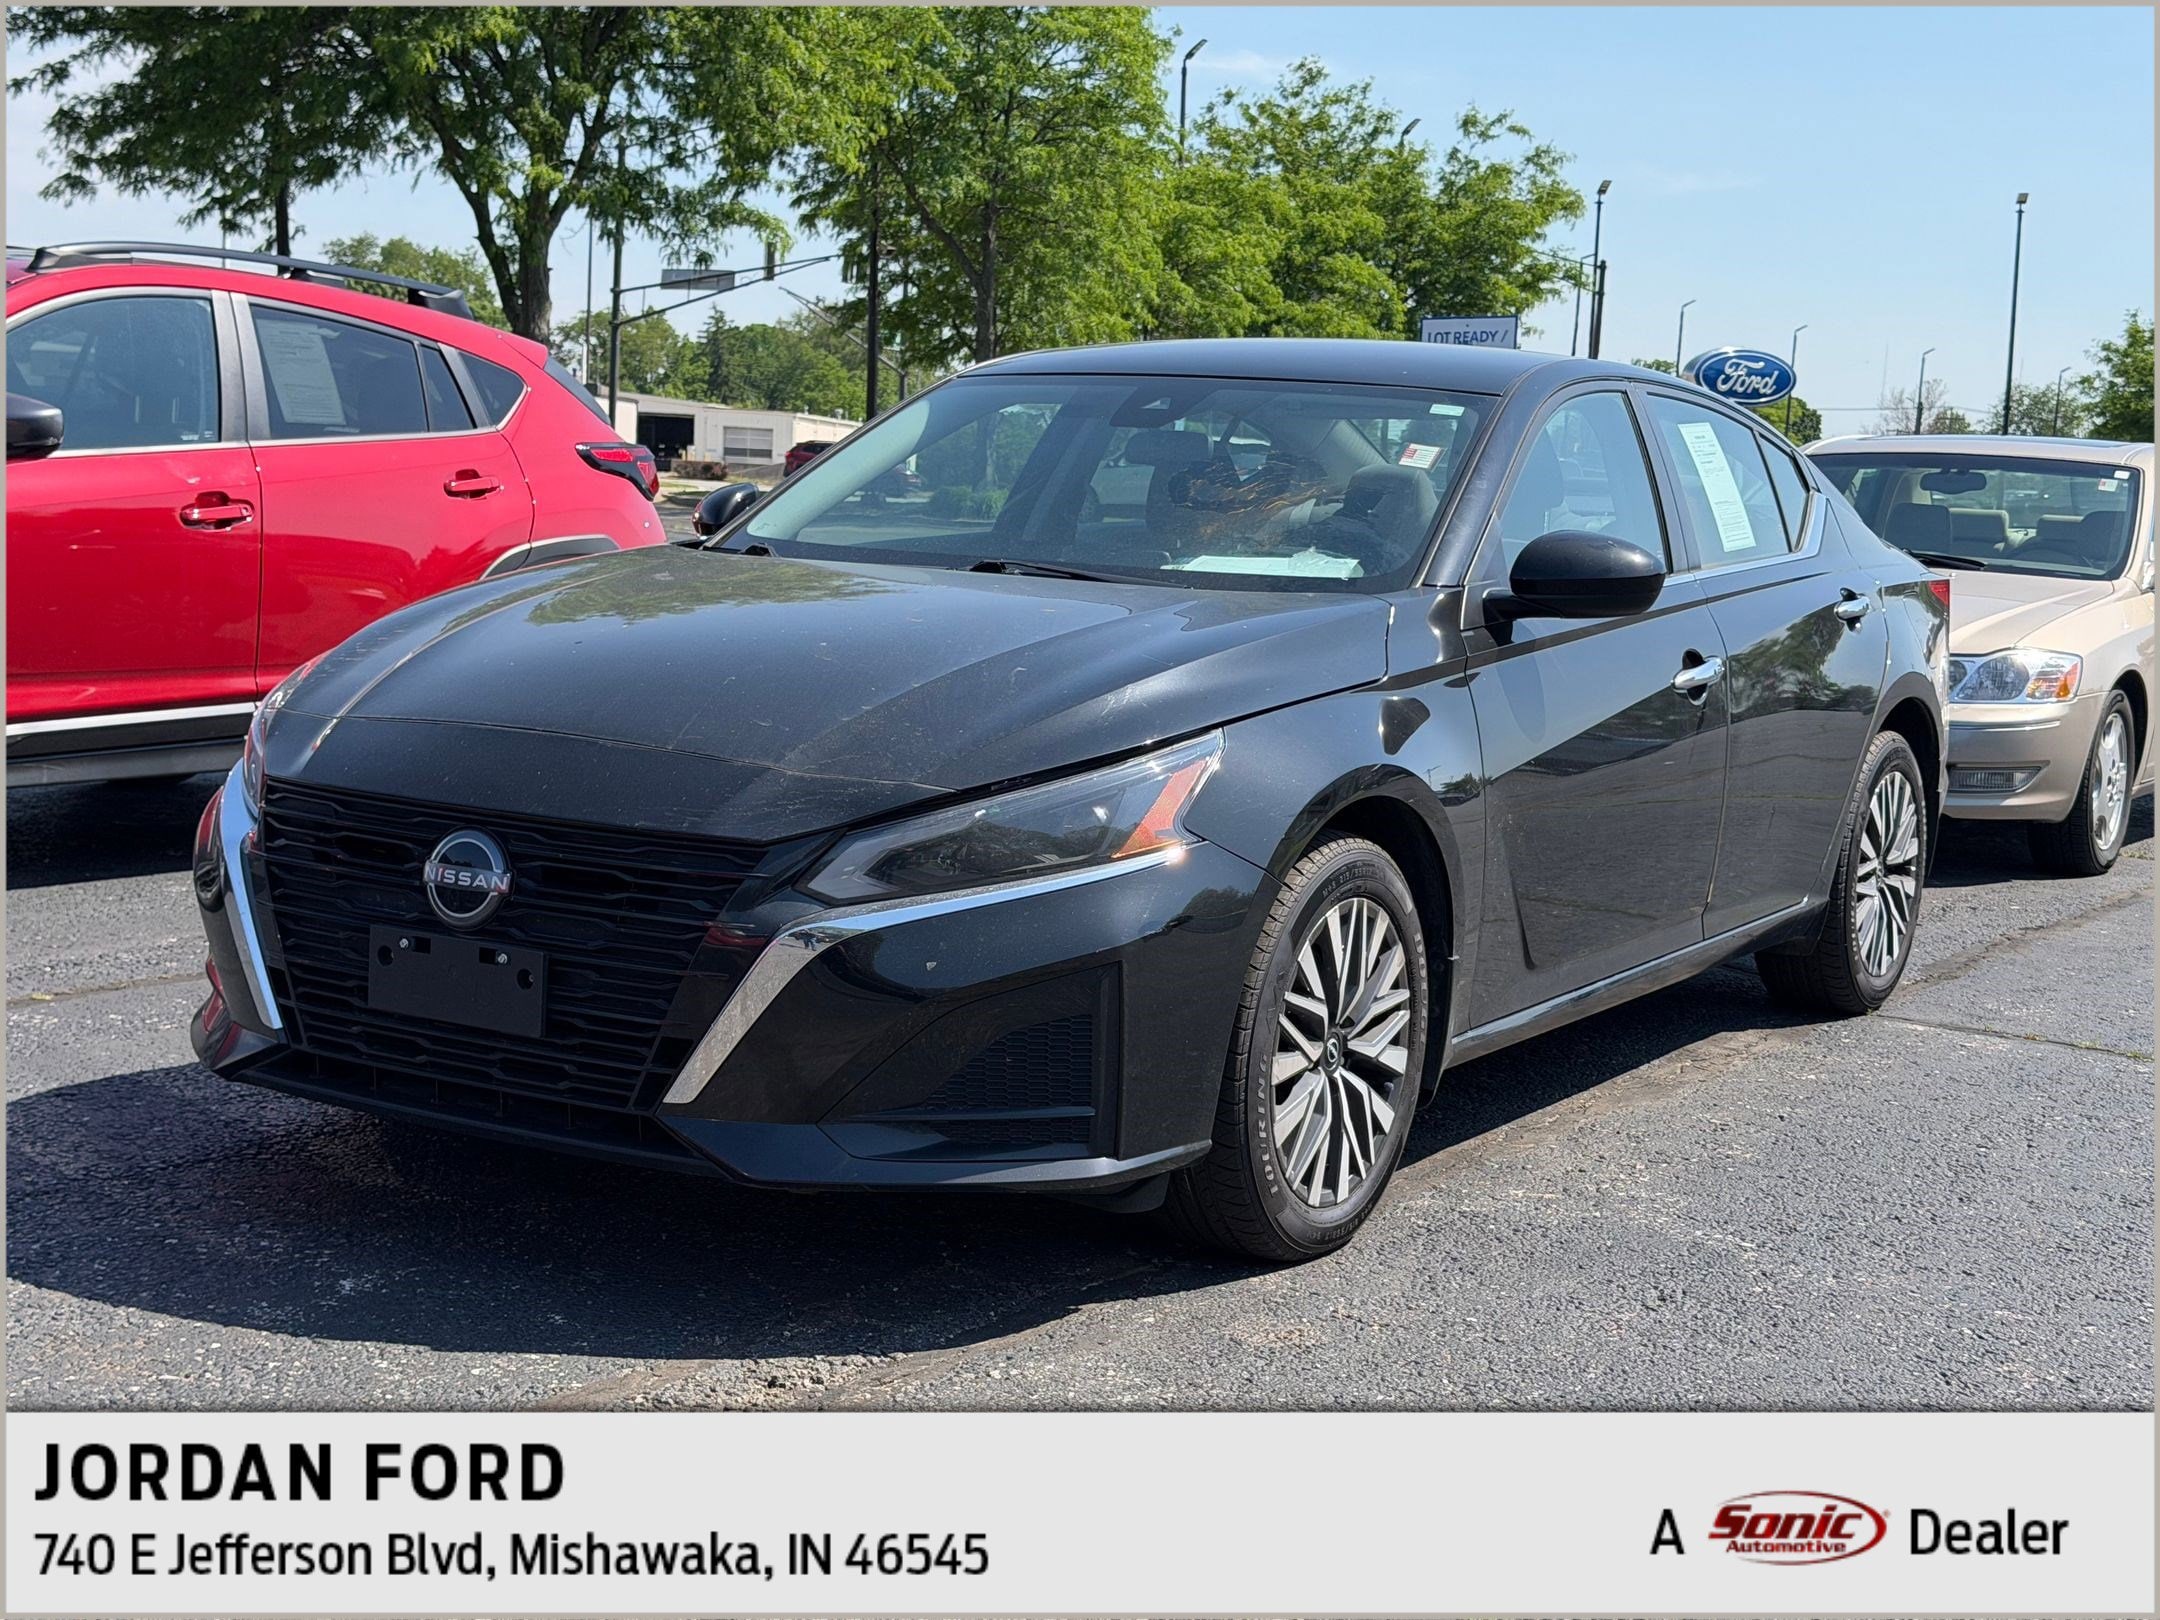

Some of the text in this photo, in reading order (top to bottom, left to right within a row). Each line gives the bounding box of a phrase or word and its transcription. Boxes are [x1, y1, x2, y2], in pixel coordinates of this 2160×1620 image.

[1427, 331, 1452, 344] LOT
[1453, 330, 1499, 344] READY
[1716, 359, 1779, 394] Ford
[424, 863, 509, 890] NISSAN
[1256, 1054, 1279, 1198] TOURING
